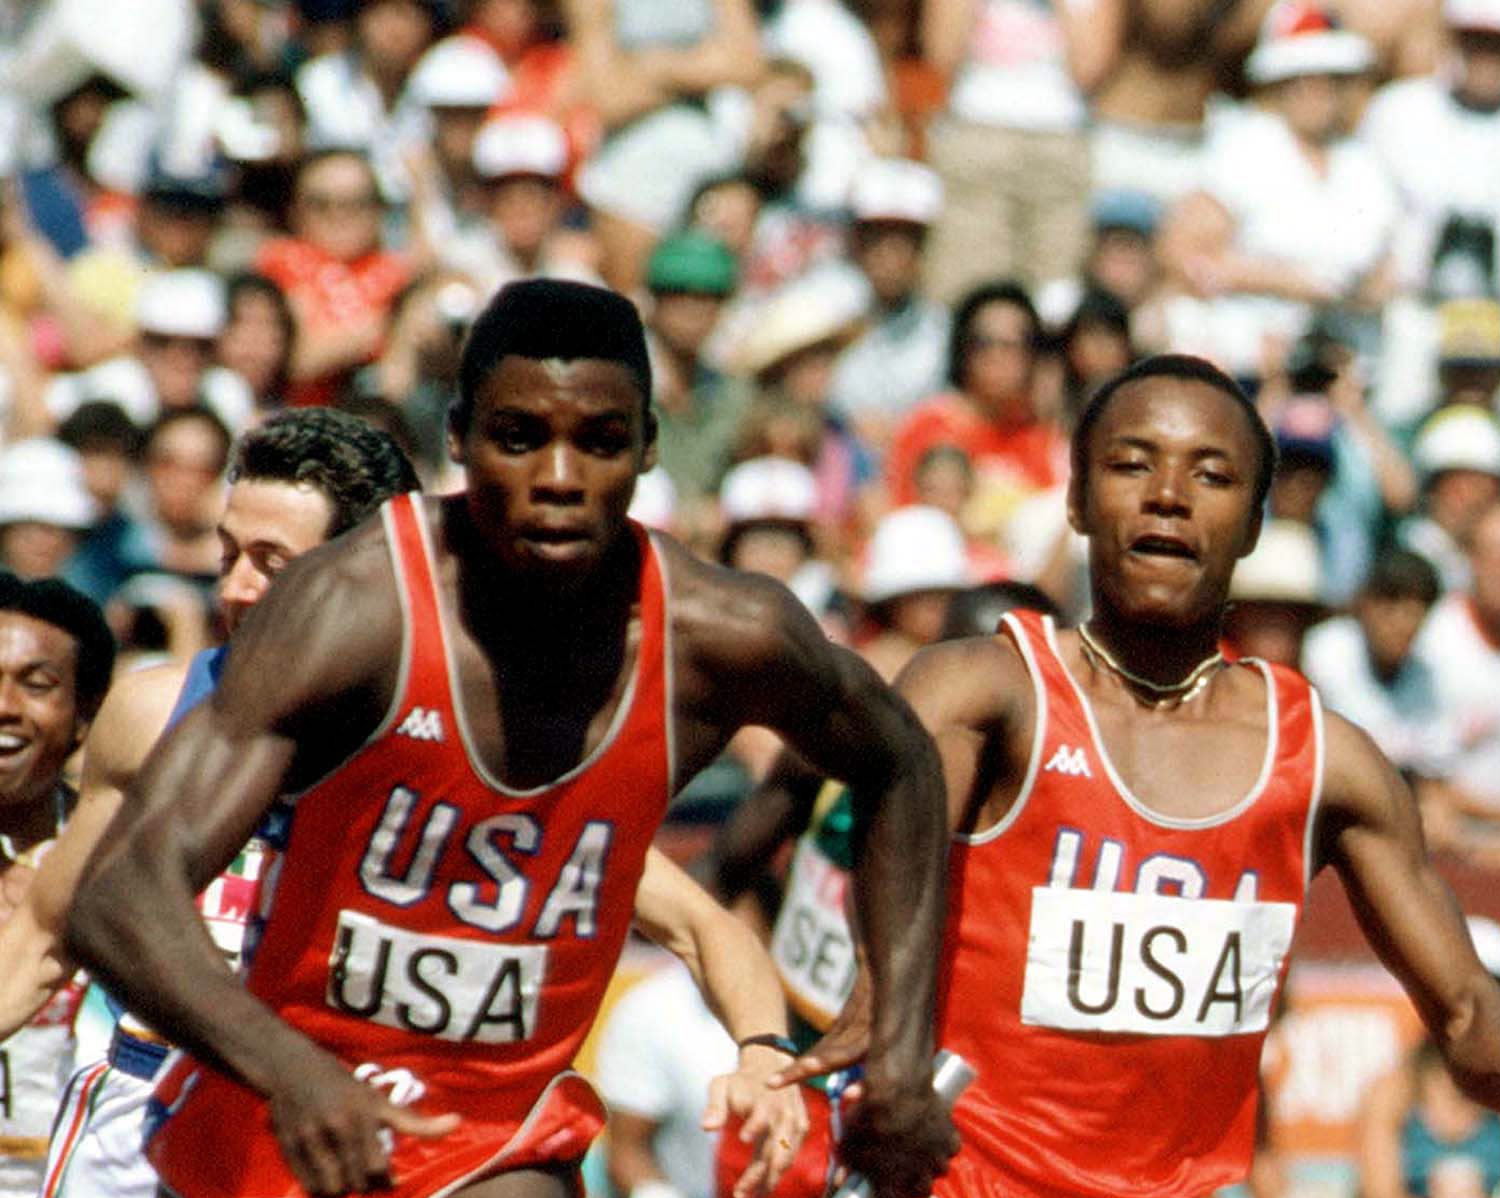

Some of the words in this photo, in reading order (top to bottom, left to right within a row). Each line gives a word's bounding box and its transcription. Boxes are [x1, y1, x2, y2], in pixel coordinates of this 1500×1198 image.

[357, 785, 615, 939] USA
[332, 925, 528, 1042] USA
[783, 906, 858, 1000] SE
[1066, 920, 1242, 1023] USA
